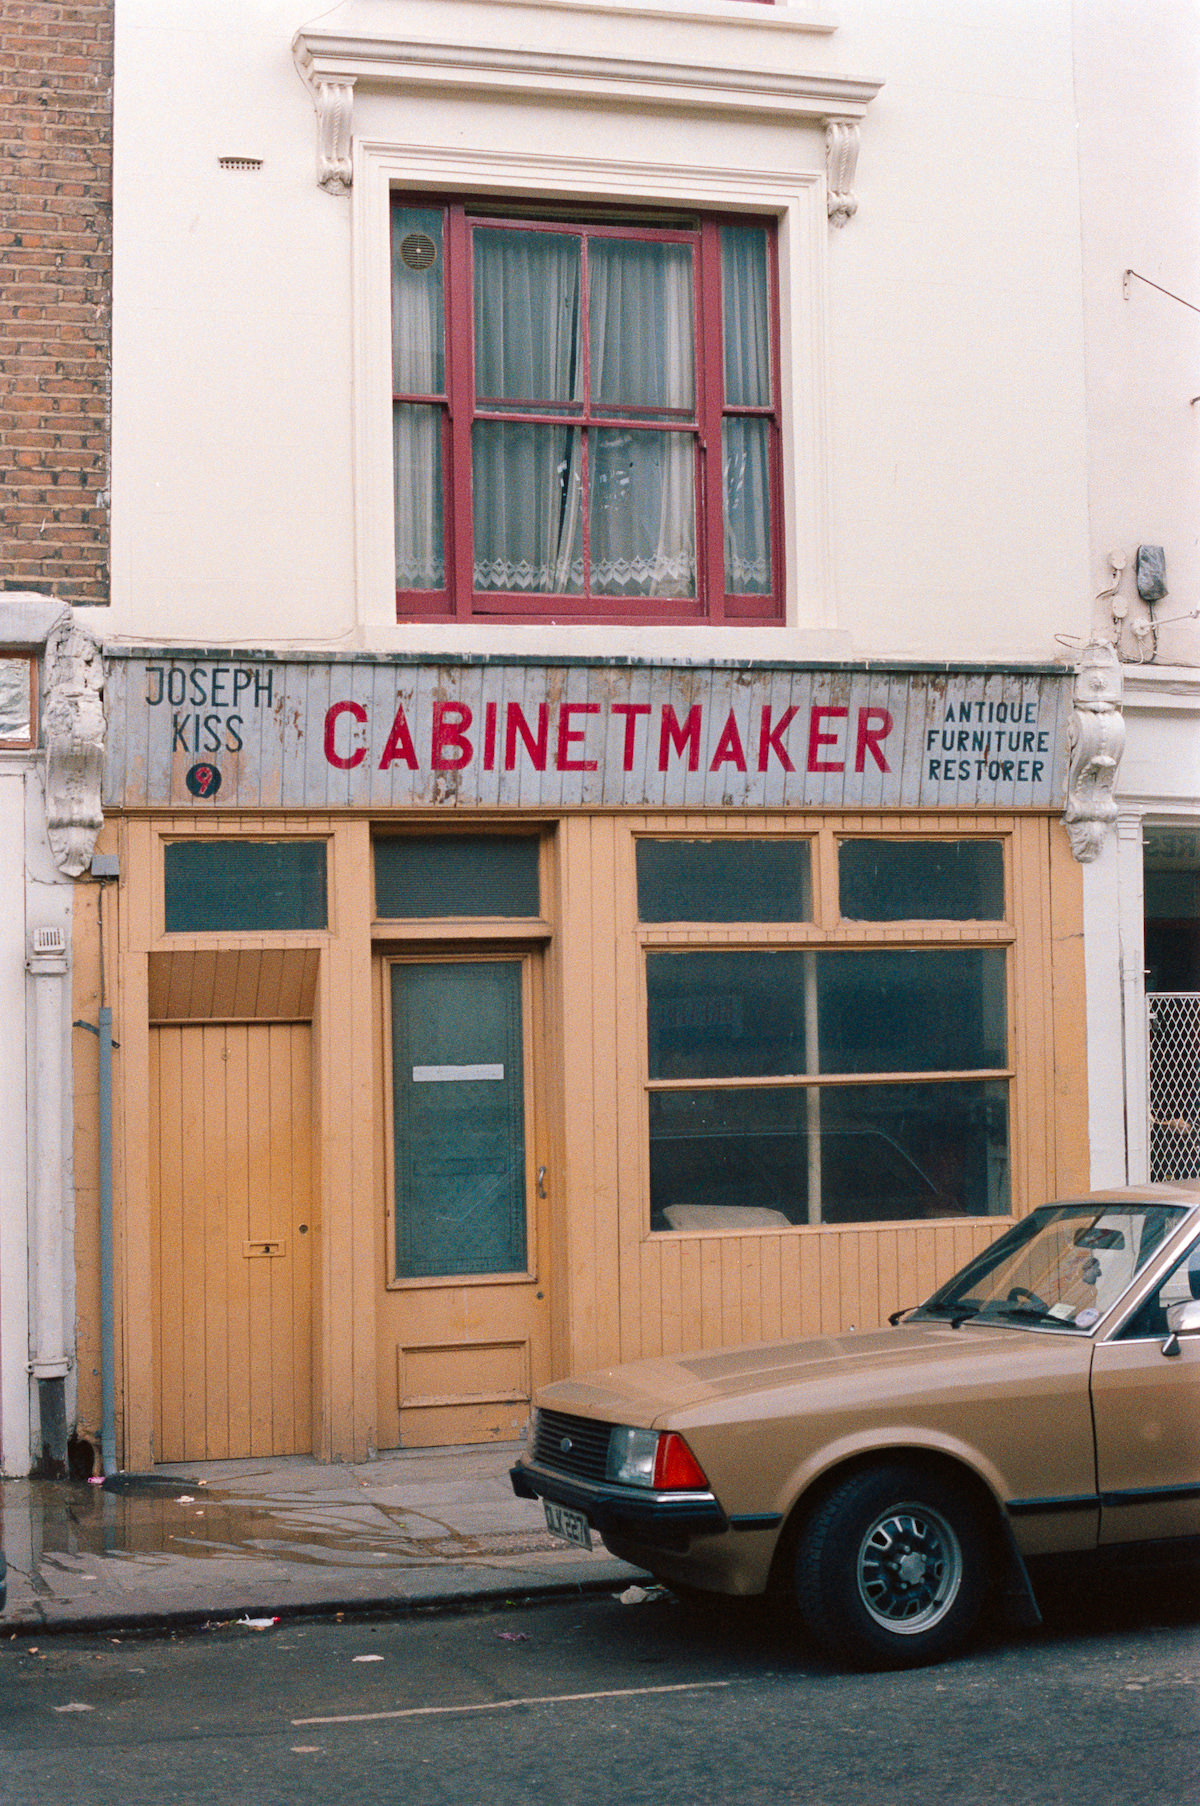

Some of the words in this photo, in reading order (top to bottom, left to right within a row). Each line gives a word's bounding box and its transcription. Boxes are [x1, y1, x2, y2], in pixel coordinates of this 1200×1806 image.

[145, 666, 273, 708] JOSEPH
[944, 700, 1037, 725] ANTIQUE
[172, 714, 244, 753] KISS
[323, 699, 894, 774] CABINETMAKER
[926, 729, 1050, 753] FURNITURE
[195, 766, 213, 795] 9
[927, 759, 1045, 783] RESTORER
